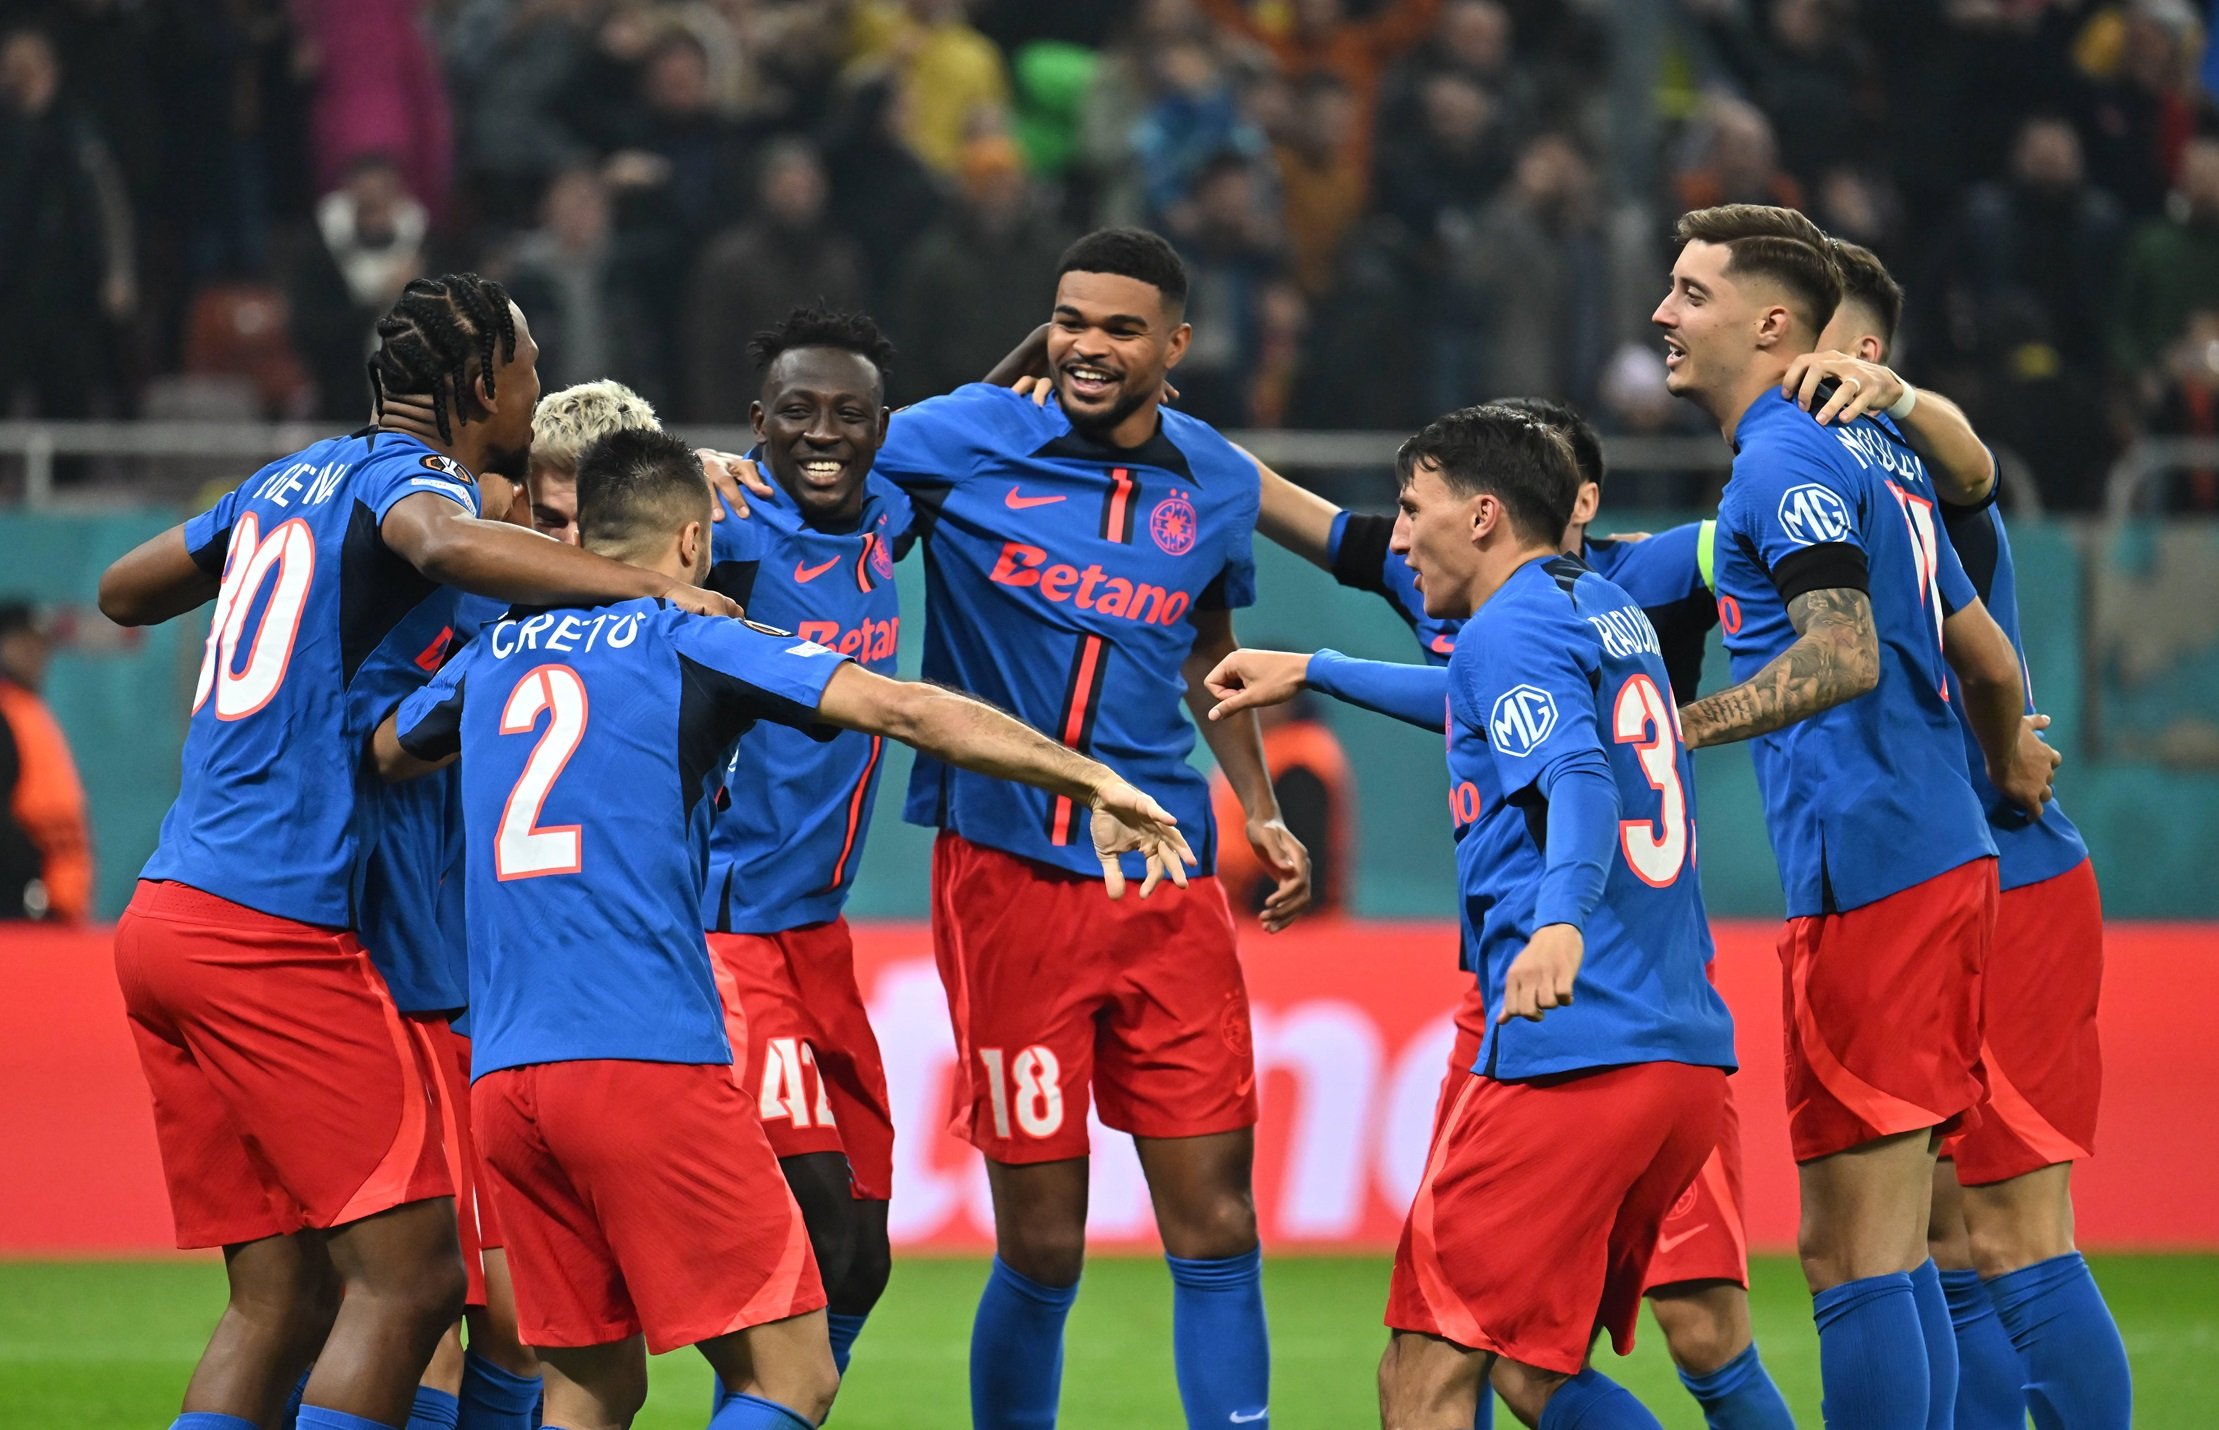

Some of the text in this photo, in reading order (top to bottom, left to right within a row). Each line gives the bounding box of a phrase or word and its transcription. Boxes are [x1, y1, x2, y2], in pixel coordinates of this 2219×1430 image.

[1783, 488, 1843, 542] MG
[989, 540, 1190, 626] Betano
[1494, 690, 1551, 750] MG
[493, 663, 590, 882] 2
[1613, 673, 1697, 889] 3
[978, 1045, 1064, 1140] 18
